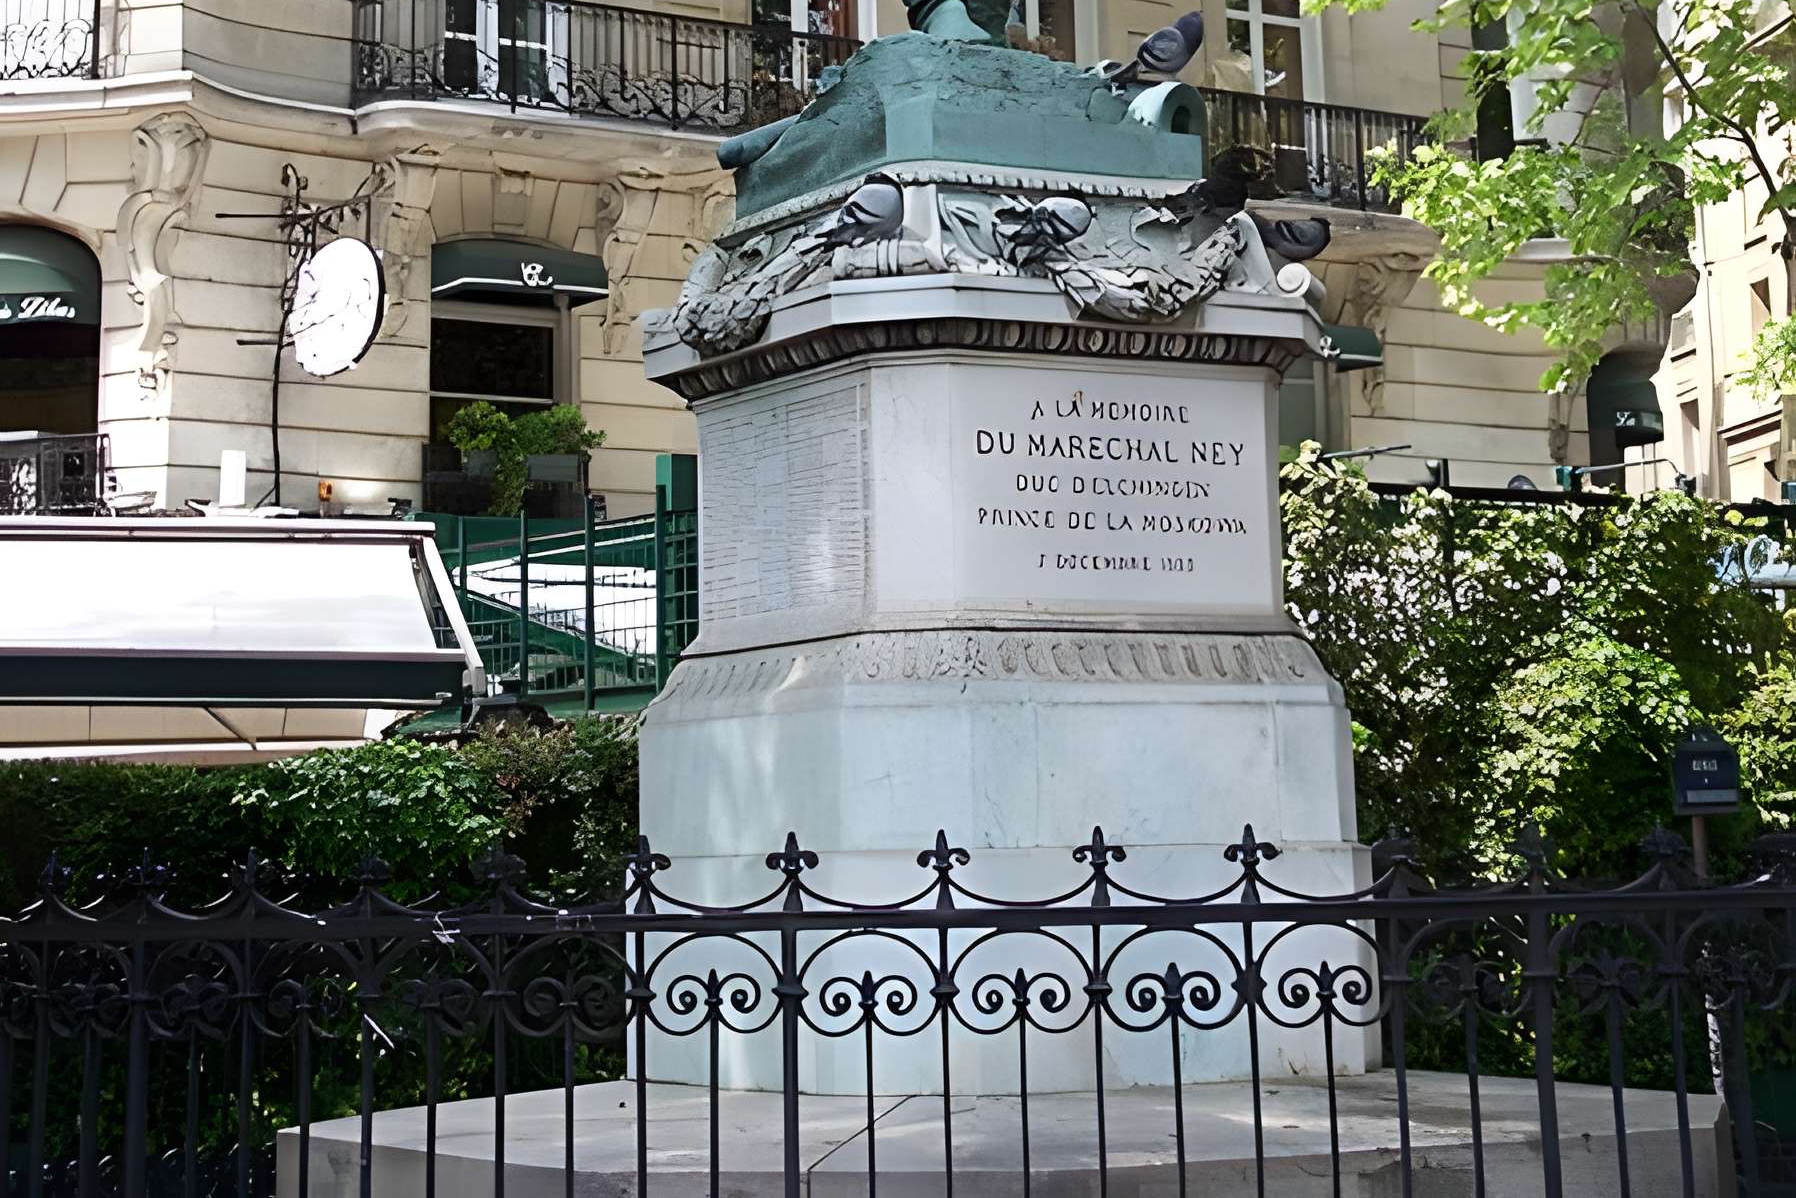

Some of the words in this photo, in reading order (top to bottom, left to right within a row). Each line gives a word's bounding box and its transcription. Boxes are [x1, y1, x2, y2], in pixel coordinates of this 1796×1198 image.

[1031, 400, 1045, 420] A
[977, 429, 1015, 455] DU
[1028, 434, 1179, 463] MARECHAL
[1191, 441, 1244, 466] NEY
[1107, 512, 1133, 531] LA
